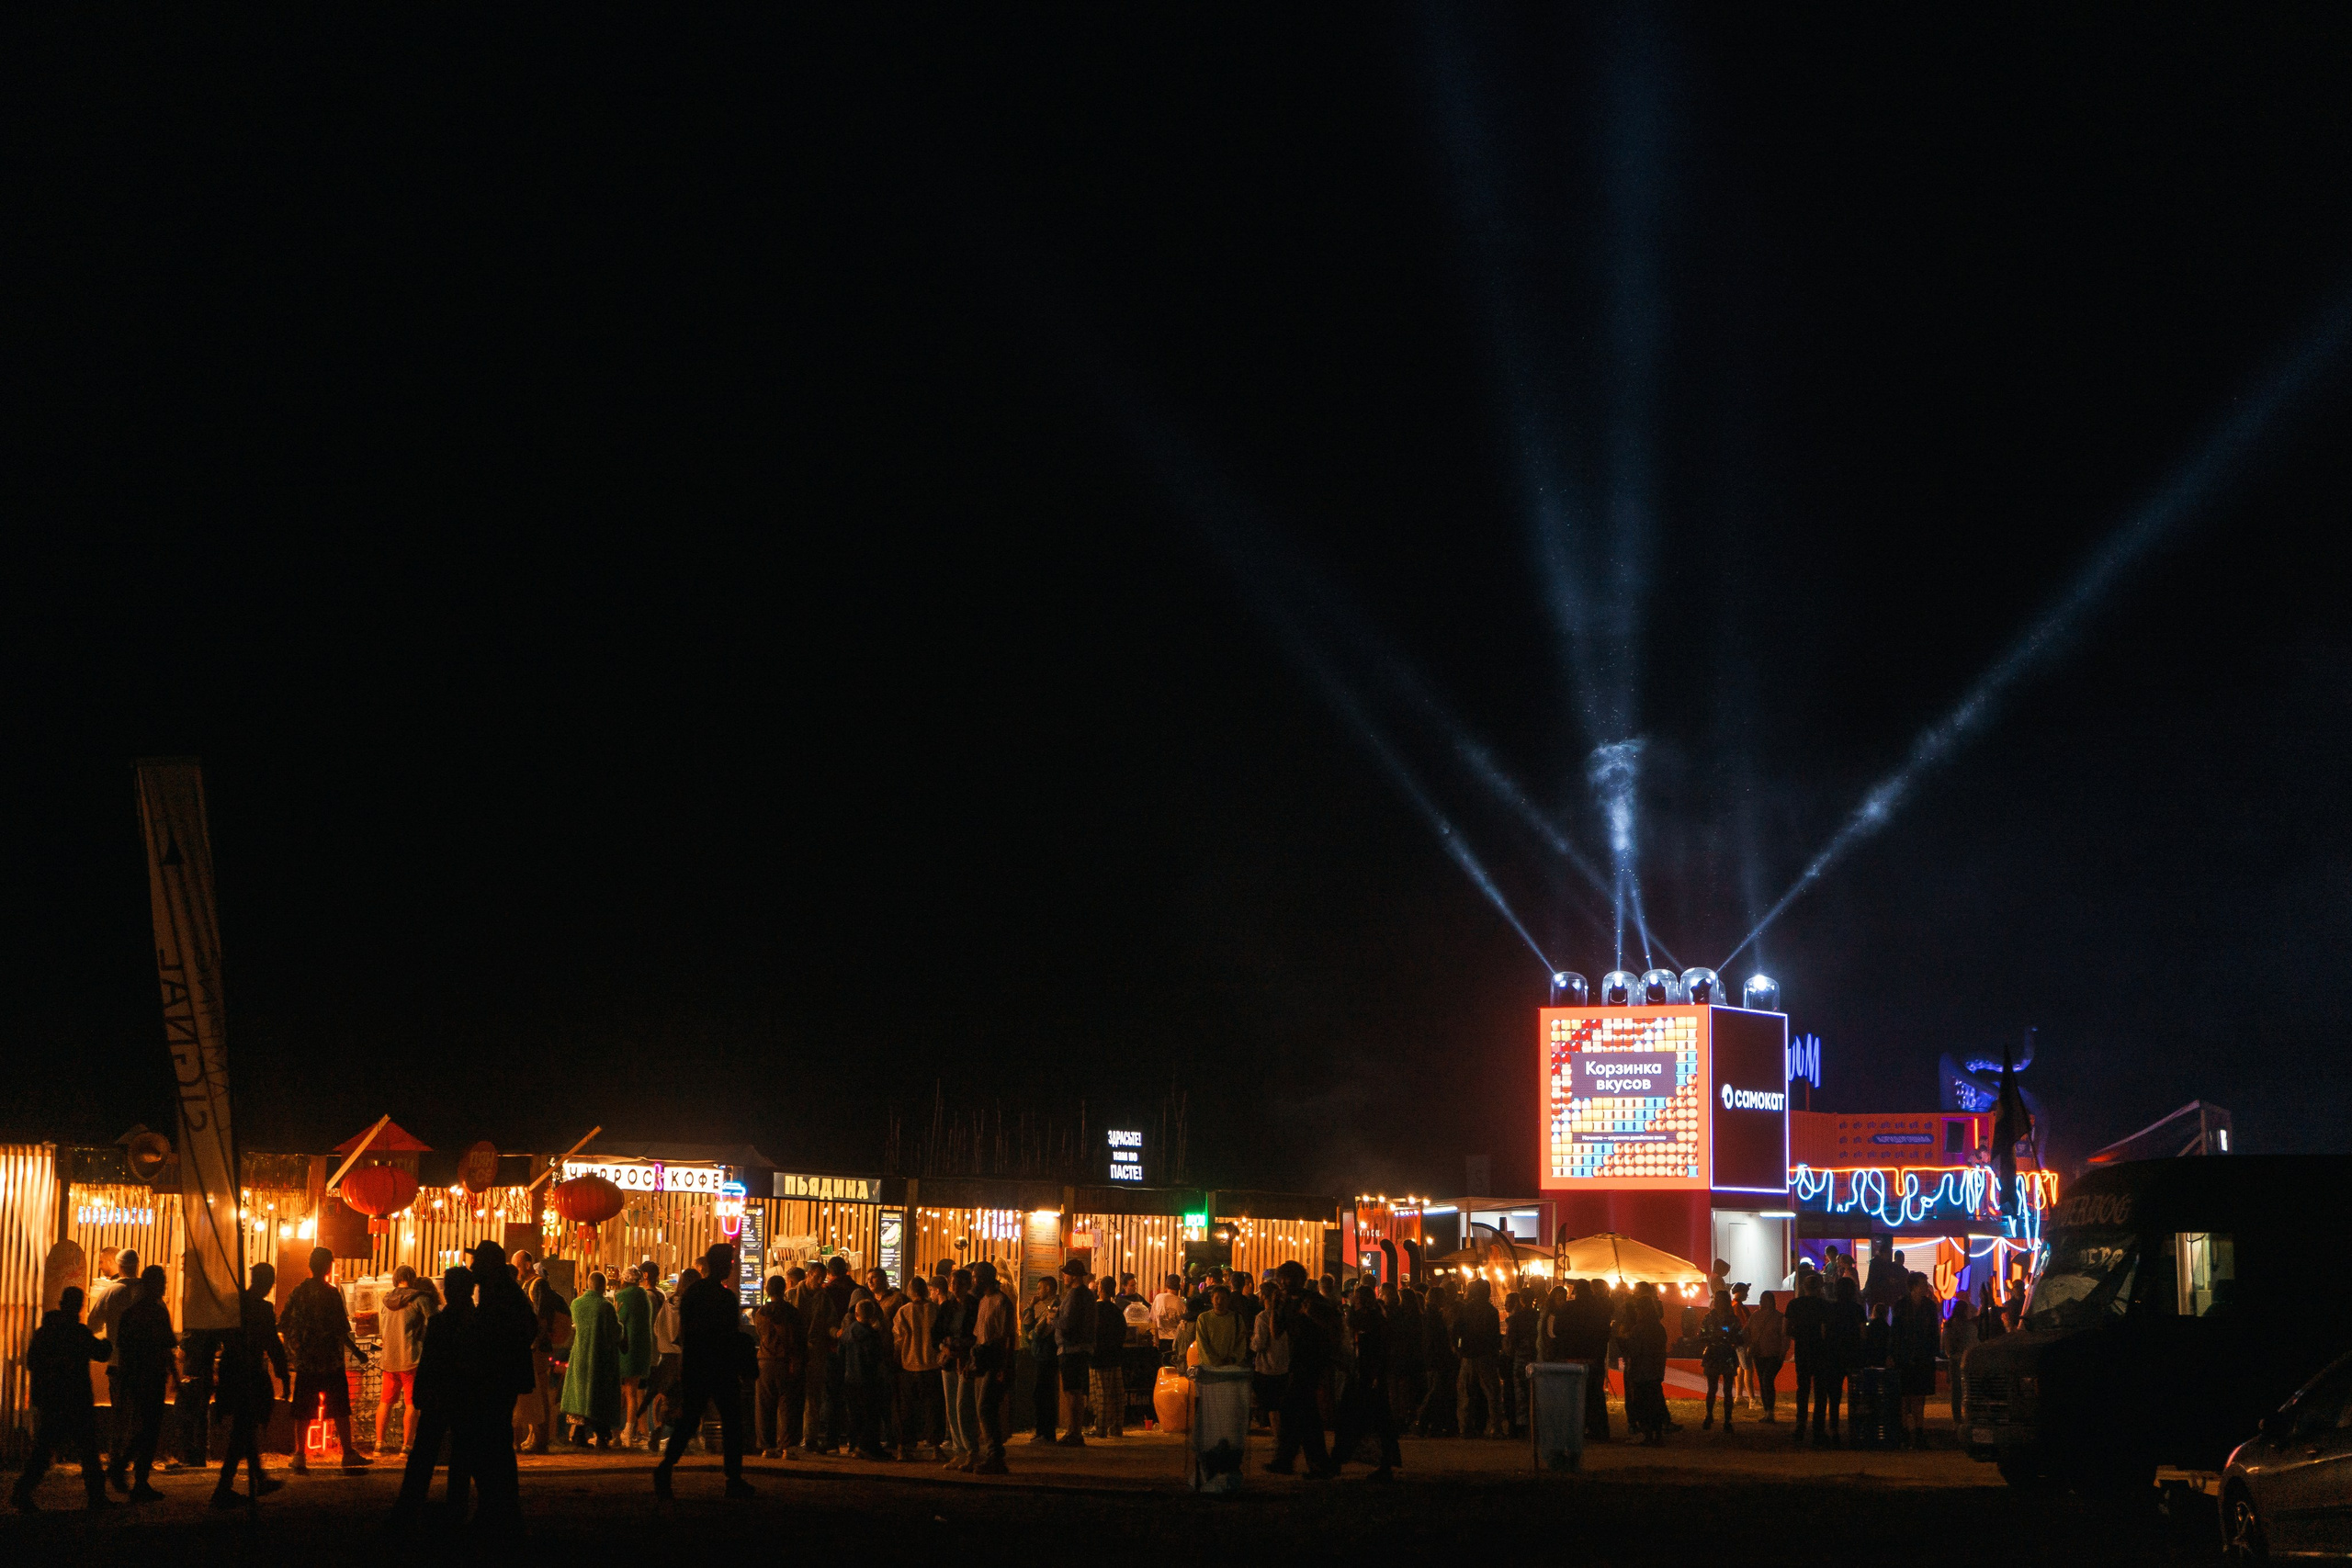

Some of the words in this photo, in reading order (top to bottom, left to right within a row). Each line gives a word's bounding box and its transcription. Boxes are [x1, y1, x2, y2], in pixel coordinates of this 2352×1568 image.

[1585, 1061, 1662, 1077] Корзинка
[1596, 1078, 1652, 1093] вкусов
[1735, 1089, 1785, 1111] самокат
[1107, 1130, 1142, 1147] ЗДРАСЬТЕ!
[670, 1170, 720, 1190] КОФЕ
[1110, 1164, 1143, 1180] ПАСТЕ!
[784, 1175, 869, 1201] ПЬЯДИНА
